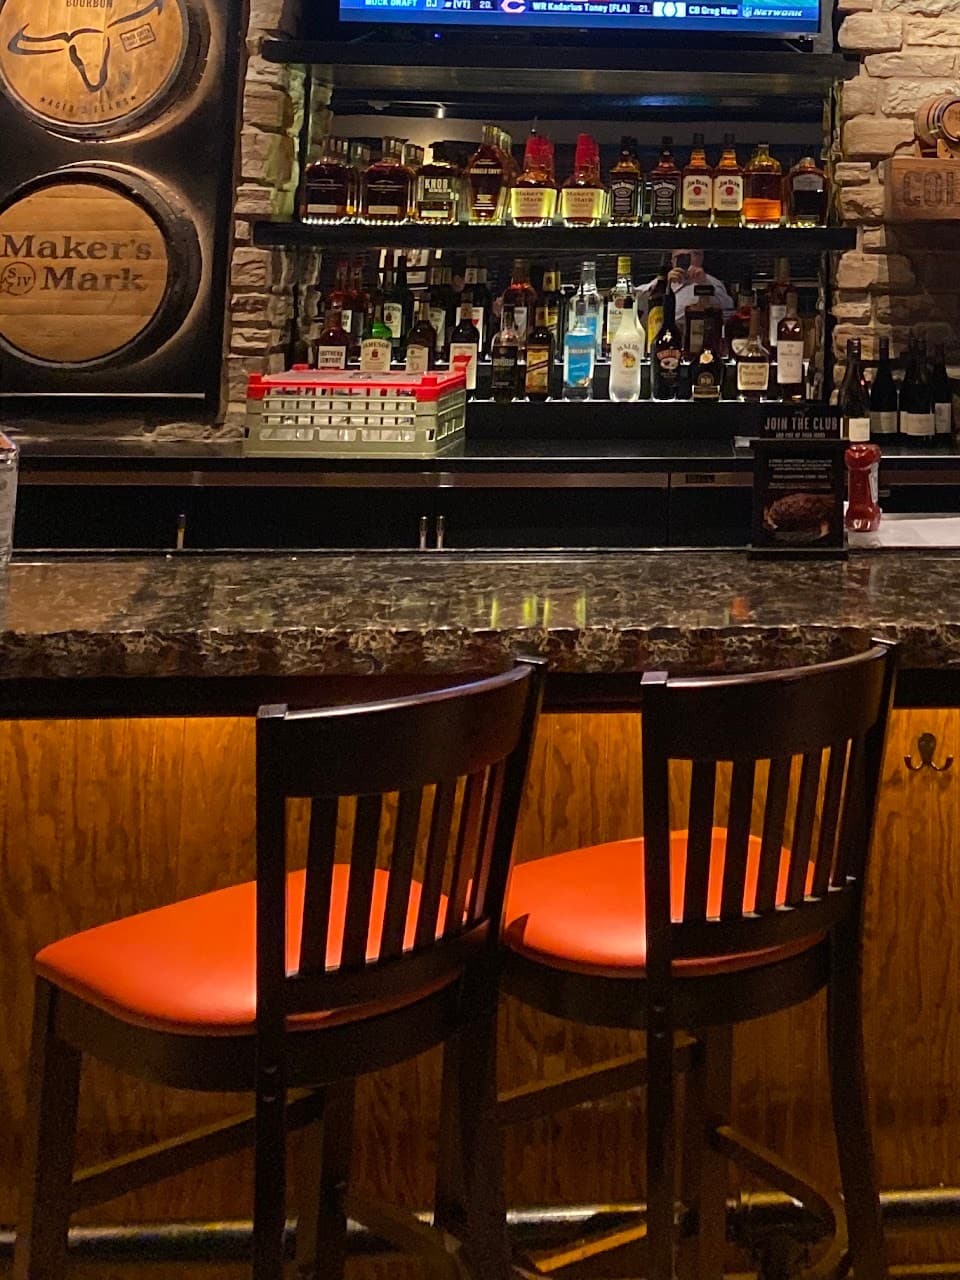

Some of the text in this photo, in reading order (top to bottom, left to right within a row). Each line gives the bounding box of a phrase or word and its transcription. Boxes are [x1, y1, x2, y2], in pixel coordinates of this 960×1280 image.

[753, 8, 803, 17] NETWORK
[424, 178, 449, 189] KNOB
[0, 233, 153, 261] Maker's
[40, 266, 147, 292] Mark
[764, 416, 838, 431] JOIN THE CLUB
